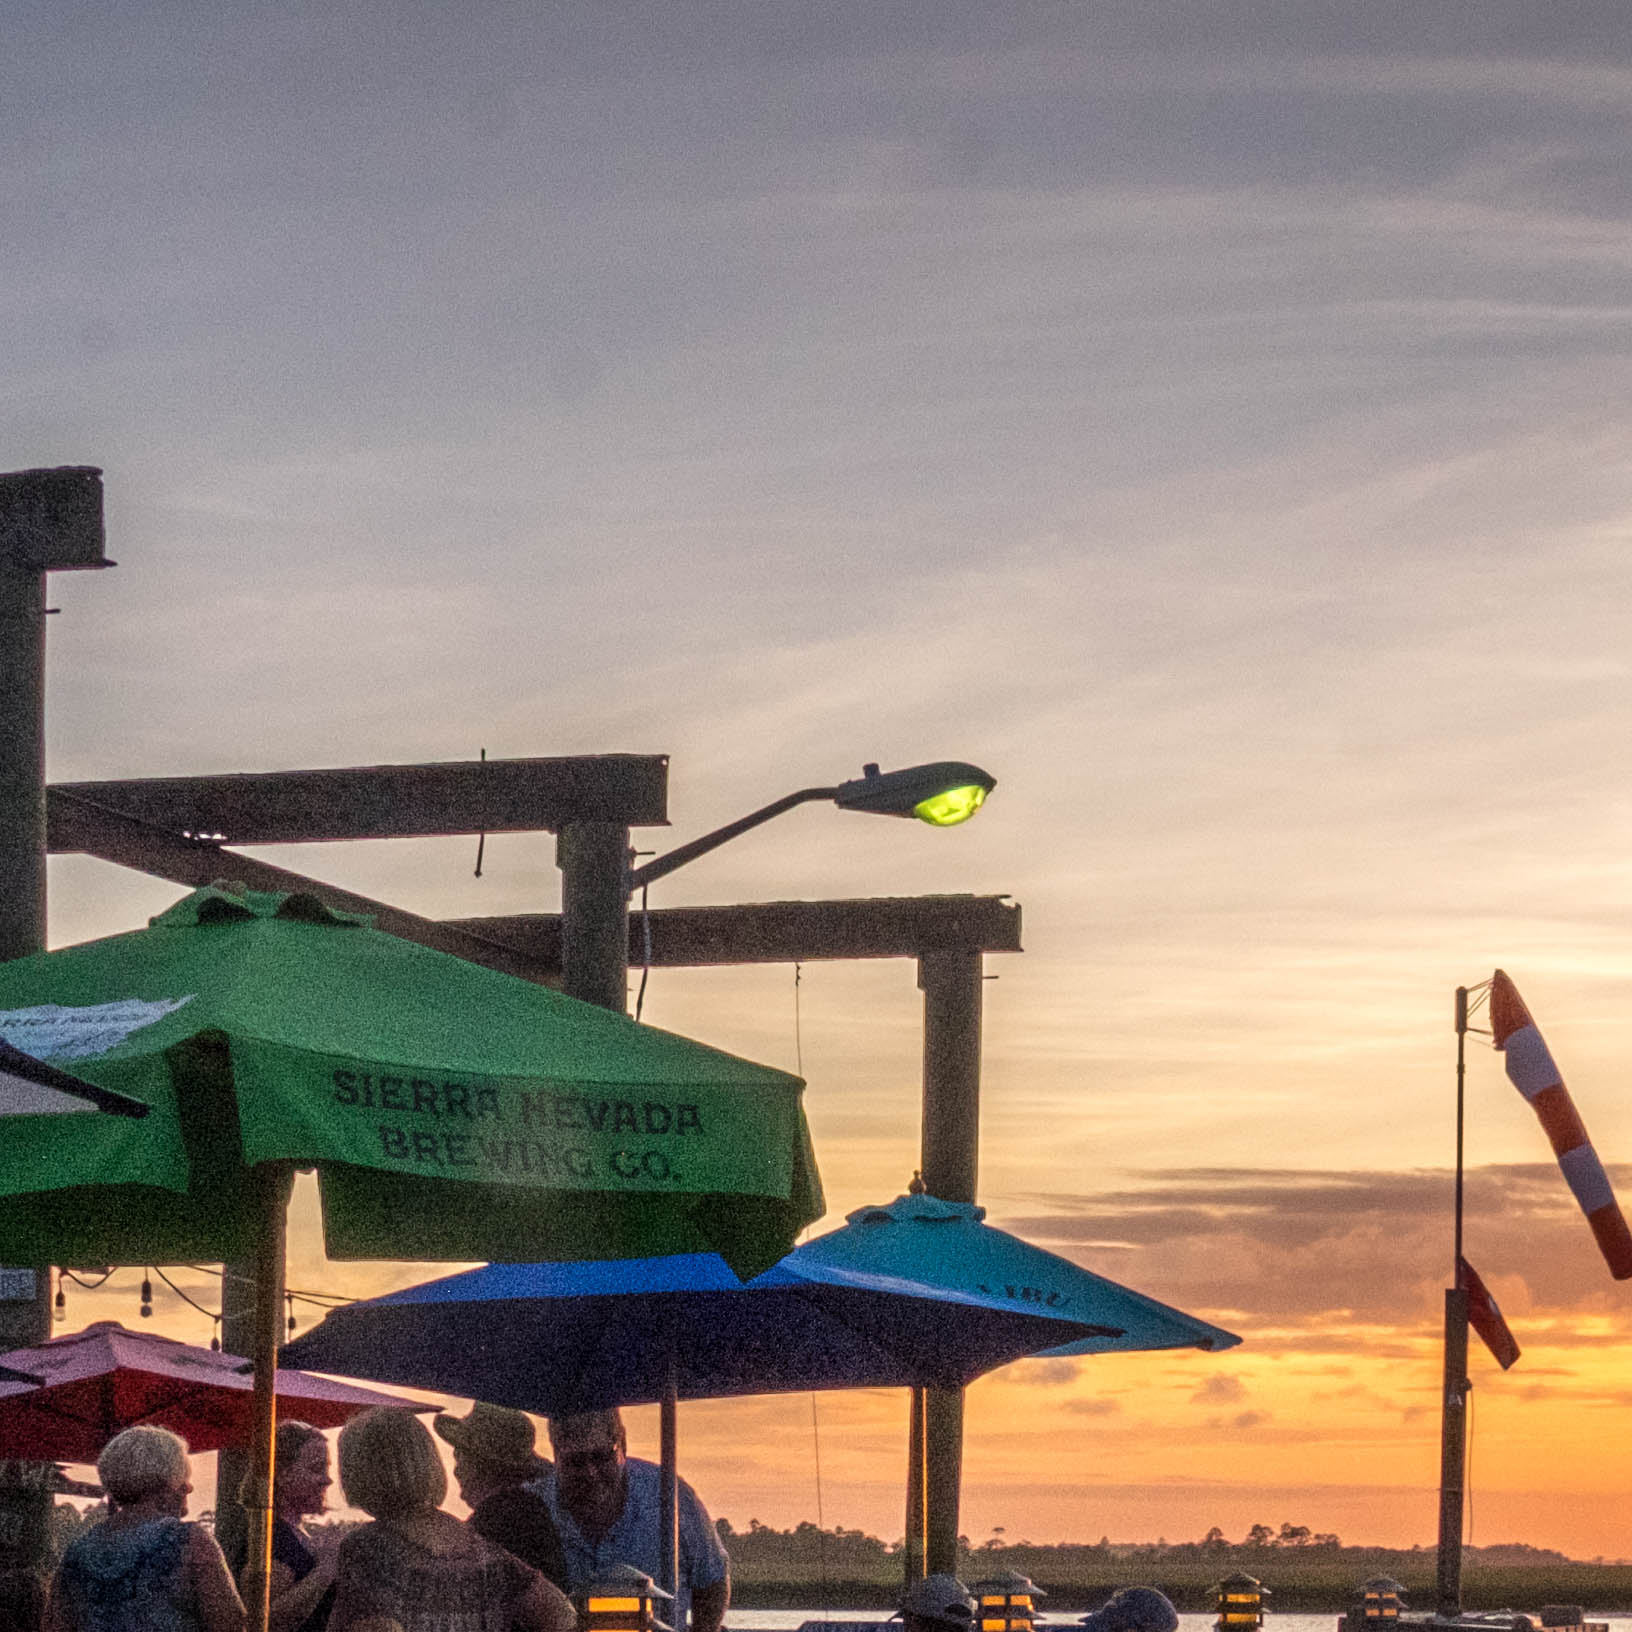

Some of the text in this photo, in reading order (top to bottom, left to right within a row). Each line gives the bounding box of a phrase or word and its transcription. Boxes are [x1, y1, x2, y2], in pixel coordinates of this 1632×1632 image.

[332, 1070, 704, 1136] SIERRA NEVADA
[378, 1125, 682, 1182] BREWING CO.
